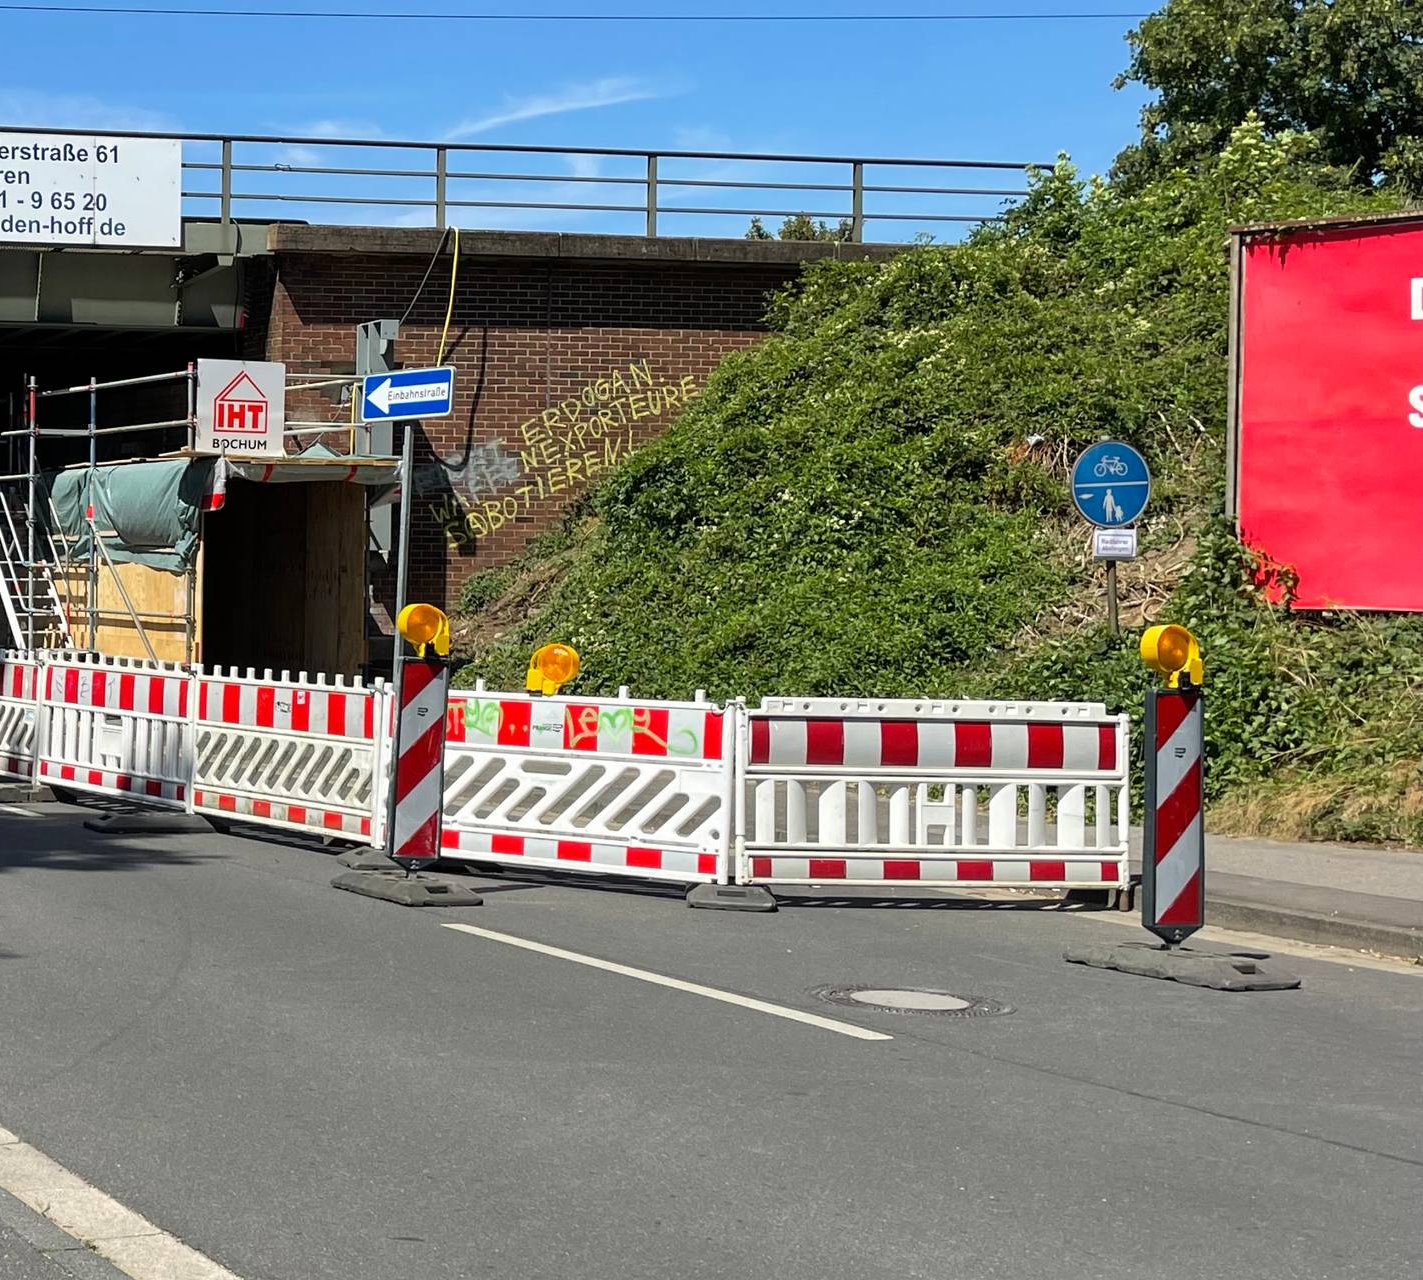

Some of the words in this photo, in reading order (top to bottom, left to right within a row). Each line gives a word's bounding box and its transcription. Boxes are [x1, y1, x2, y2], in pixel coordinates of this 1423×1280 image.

[96, 145, 119, 164] 61
[31, 191, 43, 210] 9
[50, 192, 76, 211] 65
[82, 193, 108, 212] 20
[387, 386, 446, 401] Einbahnstraße
[217, 403, 264, 429] IHT
[211, 438, 267, 450] BOCHUM
